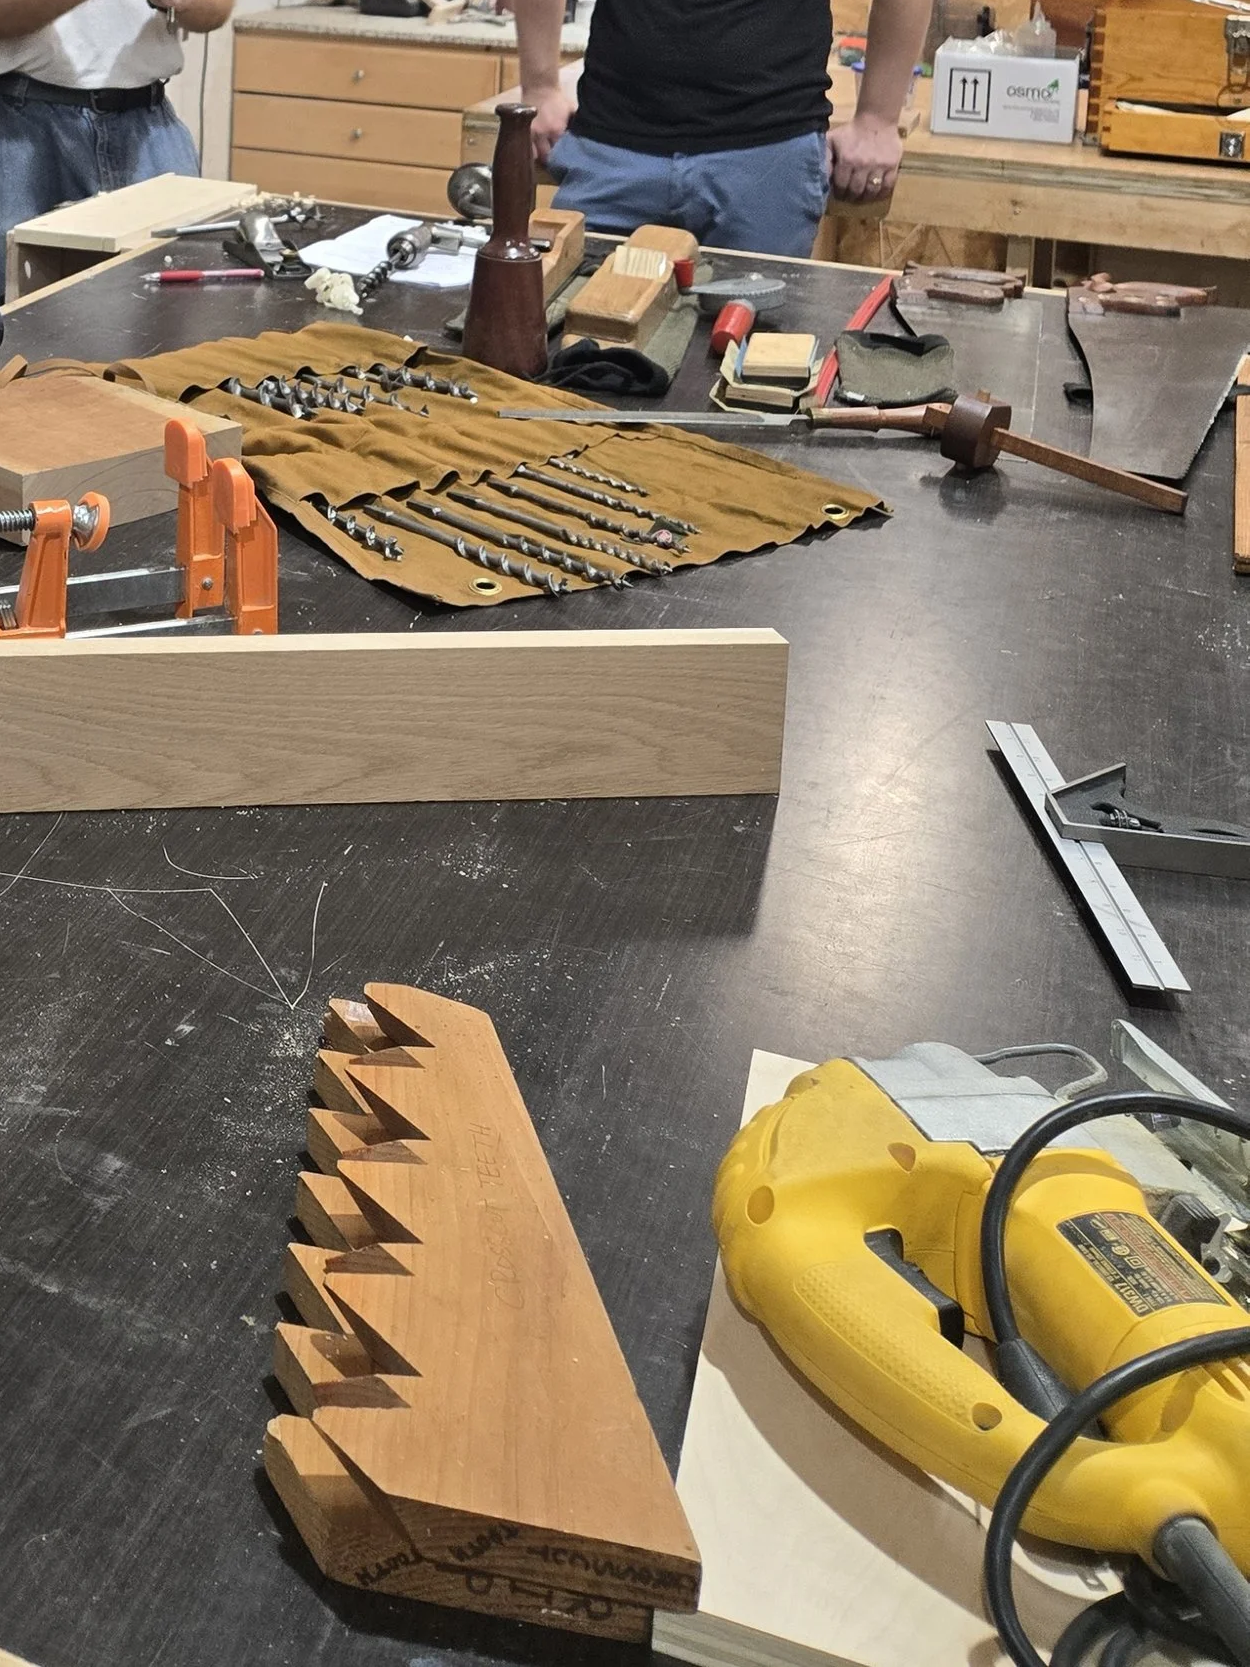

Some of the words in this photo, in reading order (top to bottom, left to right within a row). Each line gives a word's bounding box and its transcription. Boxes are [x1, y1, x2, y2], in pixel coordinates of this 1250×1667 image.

[1006, 85, 1053, 101] osmo
[467, 1122, 503, 1189] TEETH
[1114, 1281, 1149, 1314] DW317
